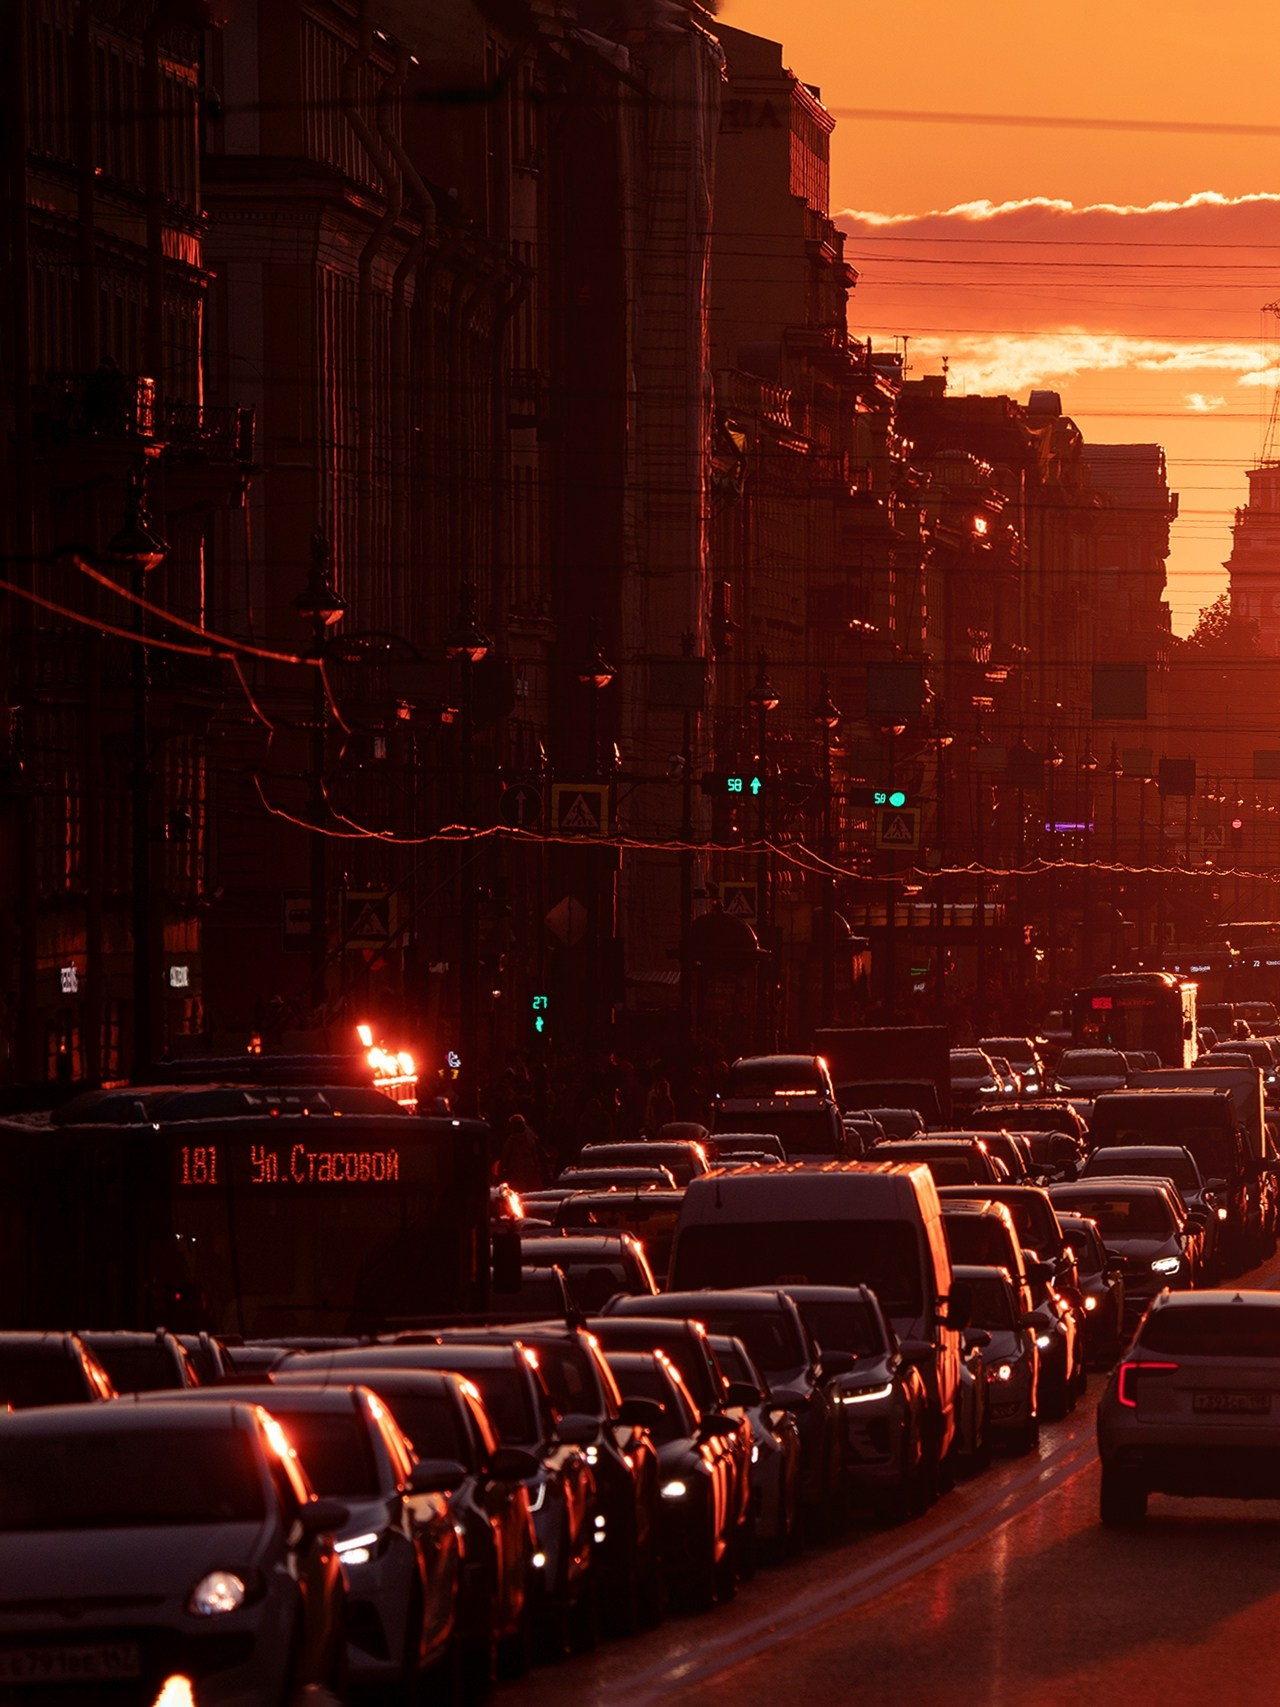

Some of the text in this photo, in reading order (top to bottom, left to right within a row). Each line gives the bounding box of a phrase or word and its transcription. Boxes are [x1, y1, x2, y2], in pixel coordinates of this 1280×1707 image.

[727, 778, 743, 792] 58
[532, 996, 548, 1010] 27
[180, 1146, 218, 1184] 181
